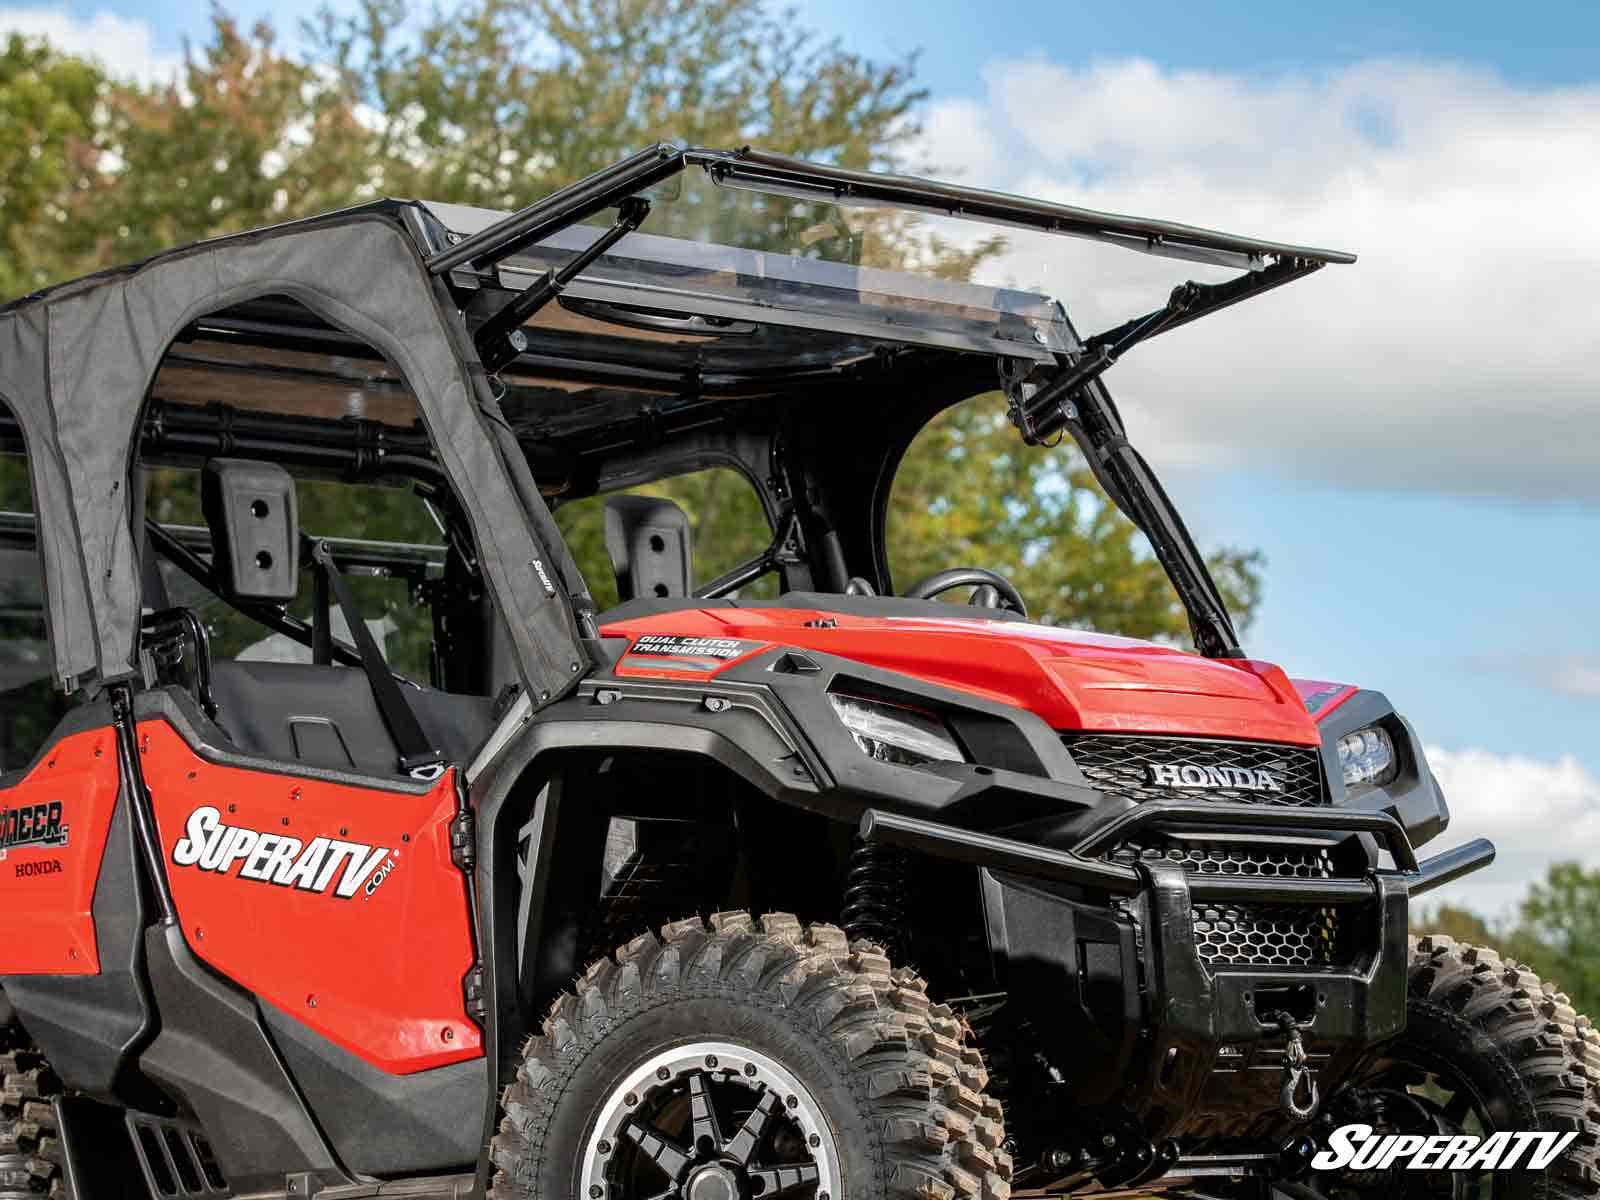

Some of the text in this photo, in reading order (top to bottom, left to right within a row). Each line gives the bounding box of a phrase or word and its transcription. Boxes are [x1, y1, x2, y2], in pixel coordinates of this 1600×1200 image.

[632, 643, 744, 658] TRANSMISSION
[638, 635, 741, 649] DUAL CLUTCH
[1149, 763, 1282, 791] HONDA
[172, 805, 390, 898] SUPERATV
[15, 859, 63, 878] HONDA
